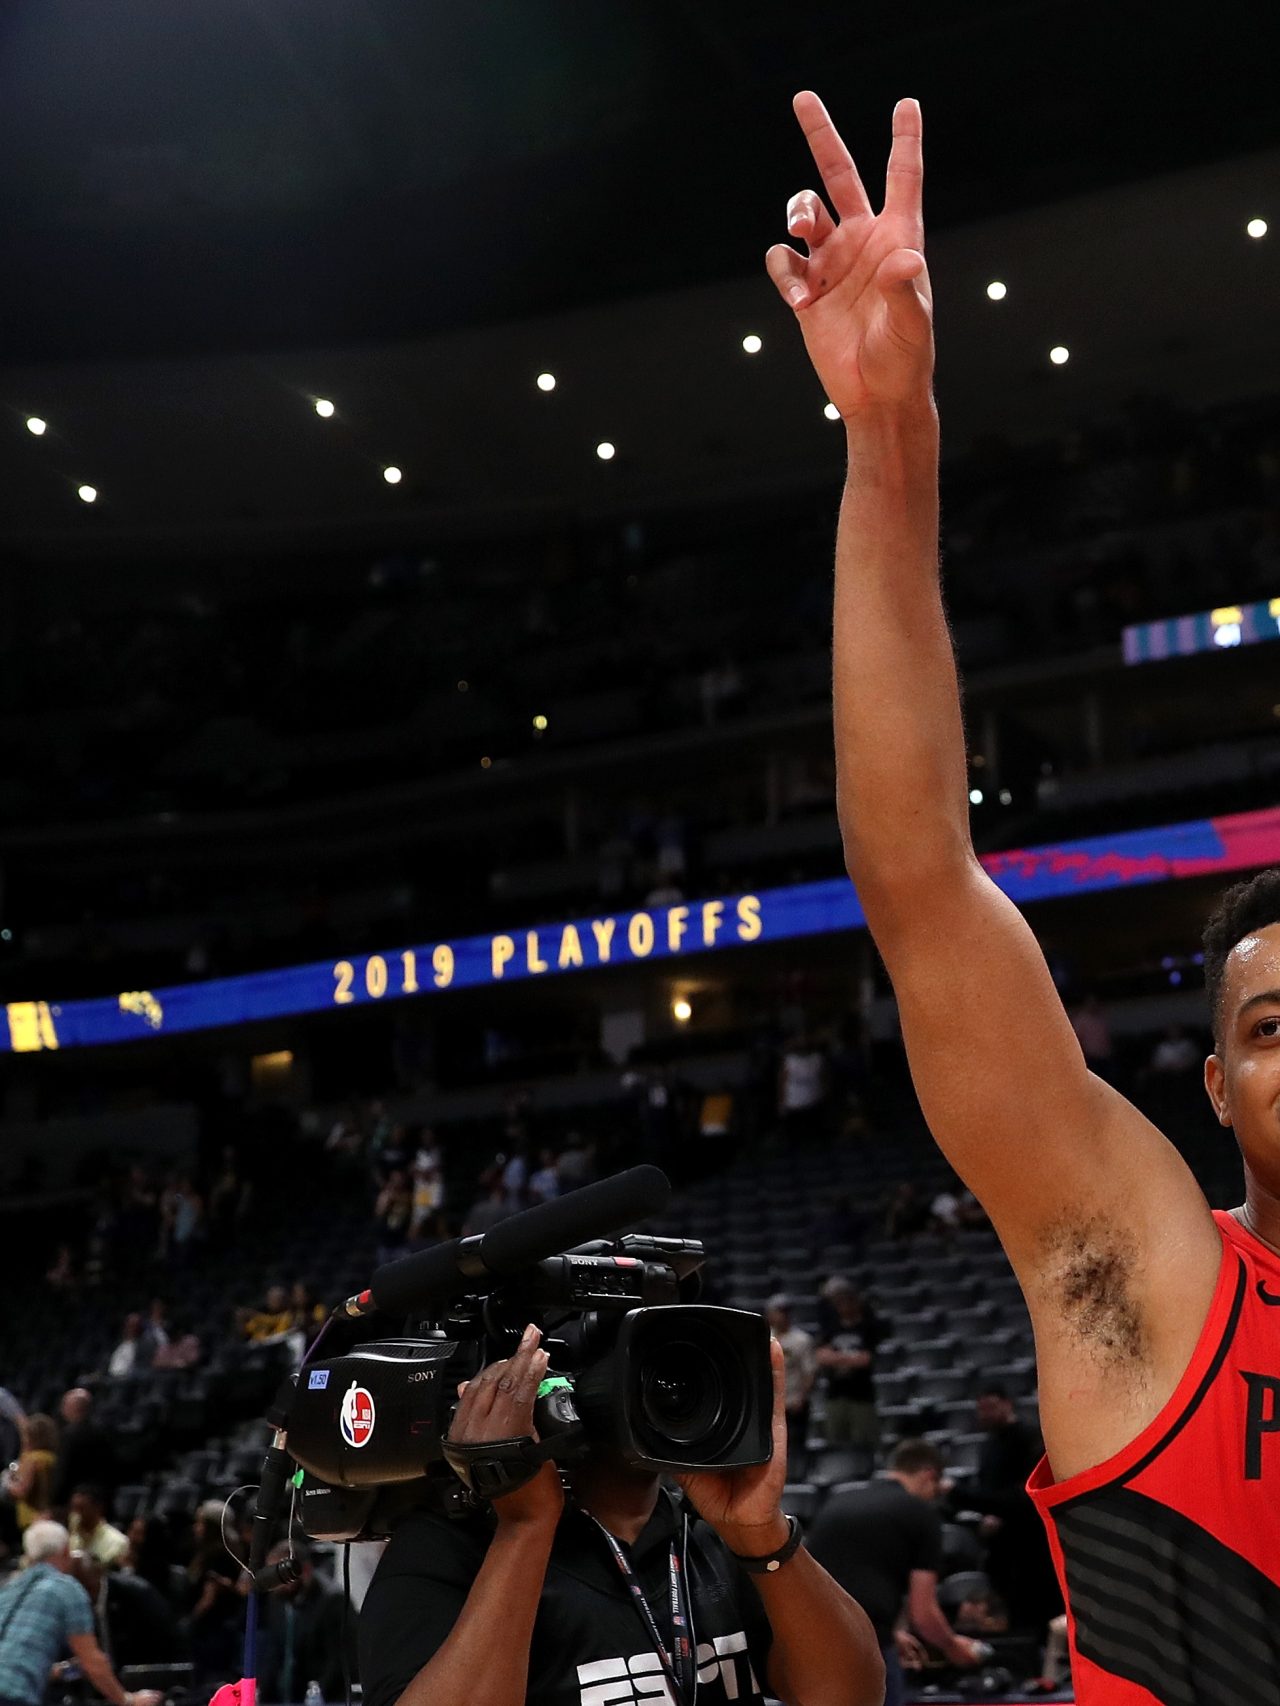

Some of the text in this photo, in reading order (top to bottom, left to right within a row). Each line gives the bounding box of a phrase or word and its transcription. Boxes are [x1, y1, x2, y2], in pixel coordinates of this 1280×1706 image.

[333, 895, 762, 1003] 2019 PLAYOFFS
[408, 1369, 437, 1383] SONY
